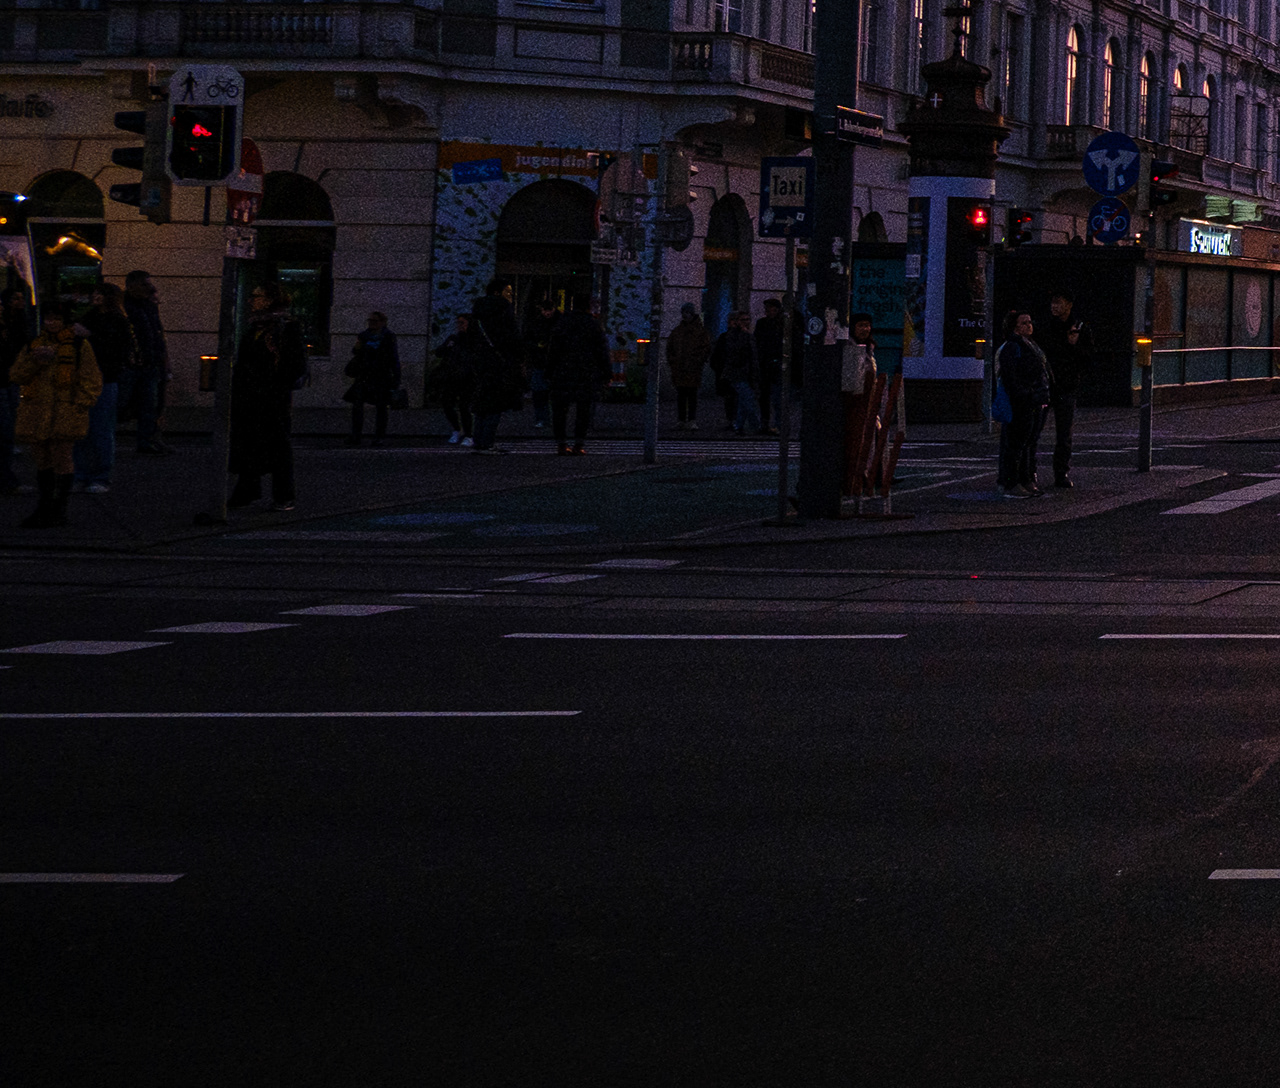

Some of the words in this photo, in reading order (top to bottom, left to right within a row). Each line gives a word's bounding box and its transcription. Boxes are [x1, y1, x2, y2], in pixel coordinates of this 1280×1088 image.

[772, 175, 803, 196] Taxi
[859, 264, 886, 279] the
[957, 318, 976, 328] The
